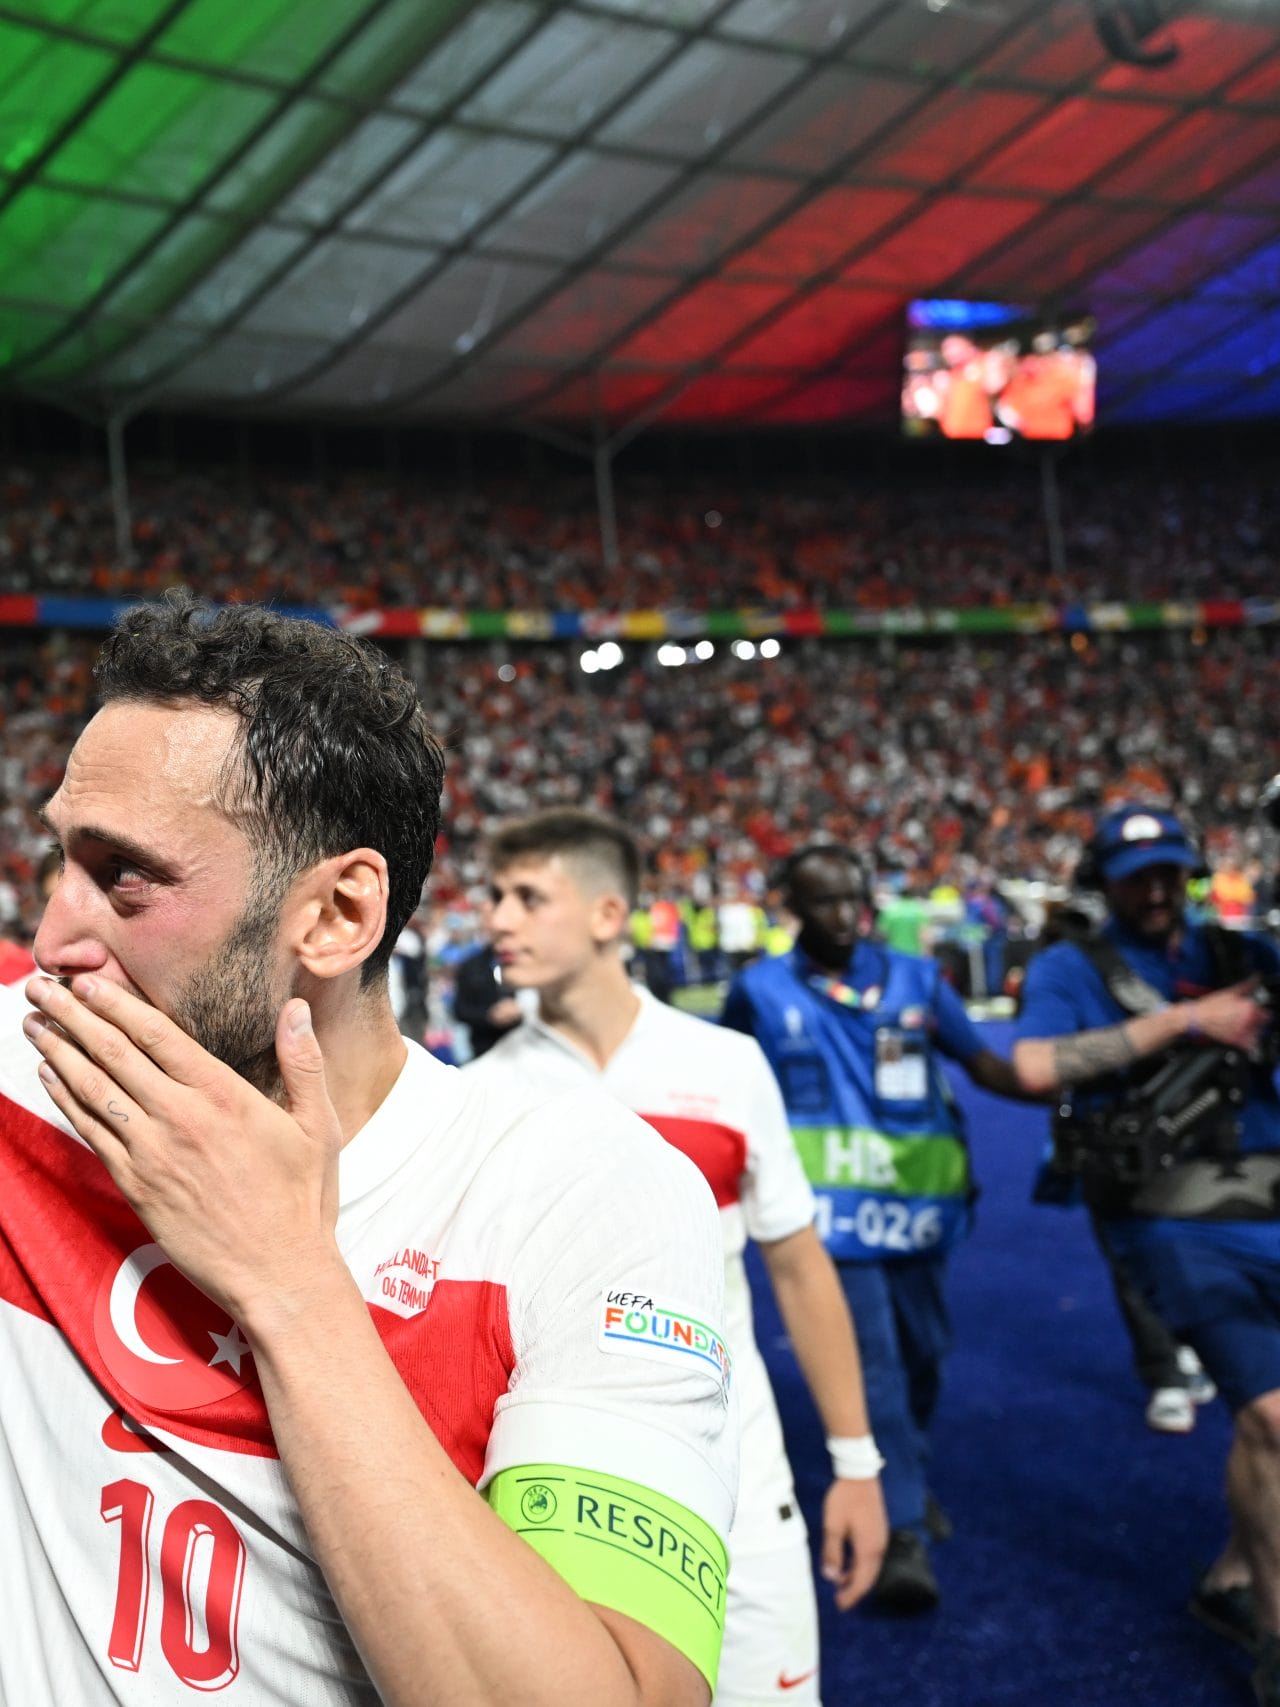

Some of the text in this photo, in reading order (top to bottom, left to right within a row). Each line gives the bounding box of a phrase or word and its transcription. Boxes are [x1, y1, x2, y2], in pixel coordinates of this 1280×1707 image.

[824, 1129, 898, 1187] HB
[382, 1276, 432, 1309] 06 TEMMU
[606, 1290, 655, 1311] UEFA
[577, 1494, 723, 1611] RESPECT
[100, 1478, 247, 1692] 10
